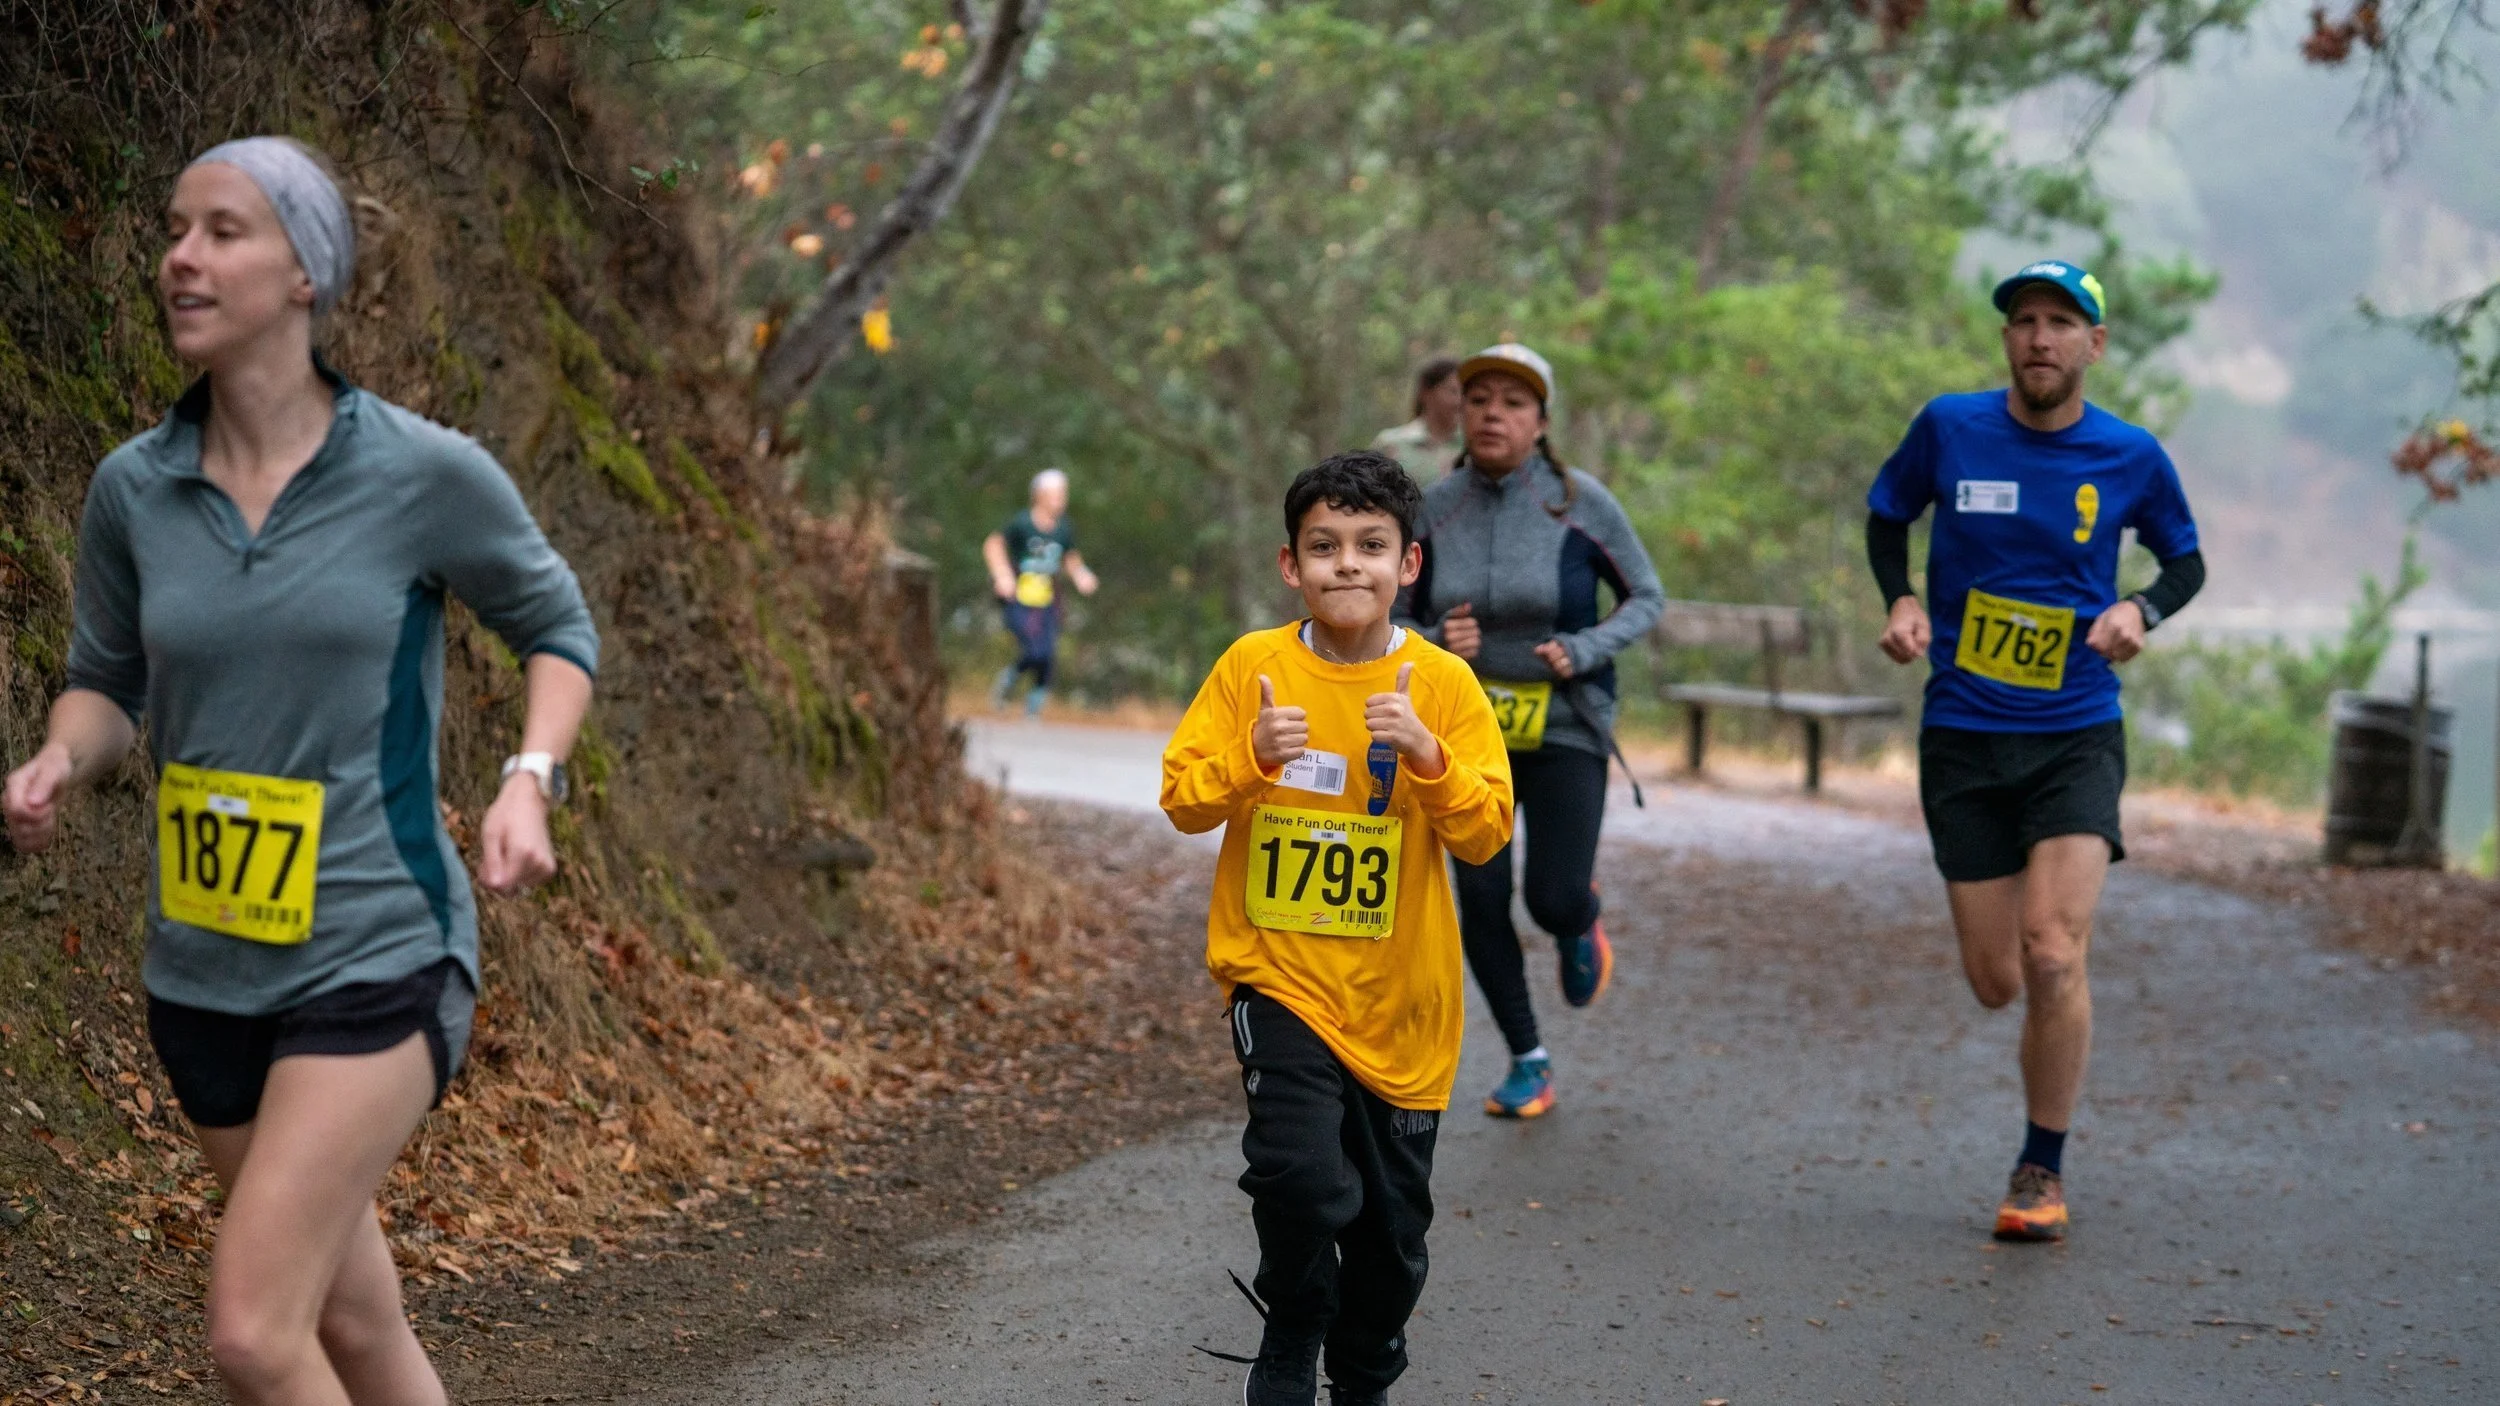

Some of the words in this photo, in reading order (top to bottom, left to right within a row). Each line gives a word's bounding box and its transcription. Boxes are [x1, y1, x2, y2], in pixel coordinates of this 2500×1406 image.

[1972, 613, 2063, 668] 1762
[1486, 692, 1539, 733] 37
[1284, 770, 1292, 780] 6
[1285, 761, 1314, 773] Student
[1264, 812, 1293, 827] Have
[1297, 816, 1320, 829] Fun
[1324, 819, 1346, 832] Out
[1350, 822, 1389, 836] There!
[168, 804, 304, 901] 1877
[1260, 836, 1390, 909] 1793
